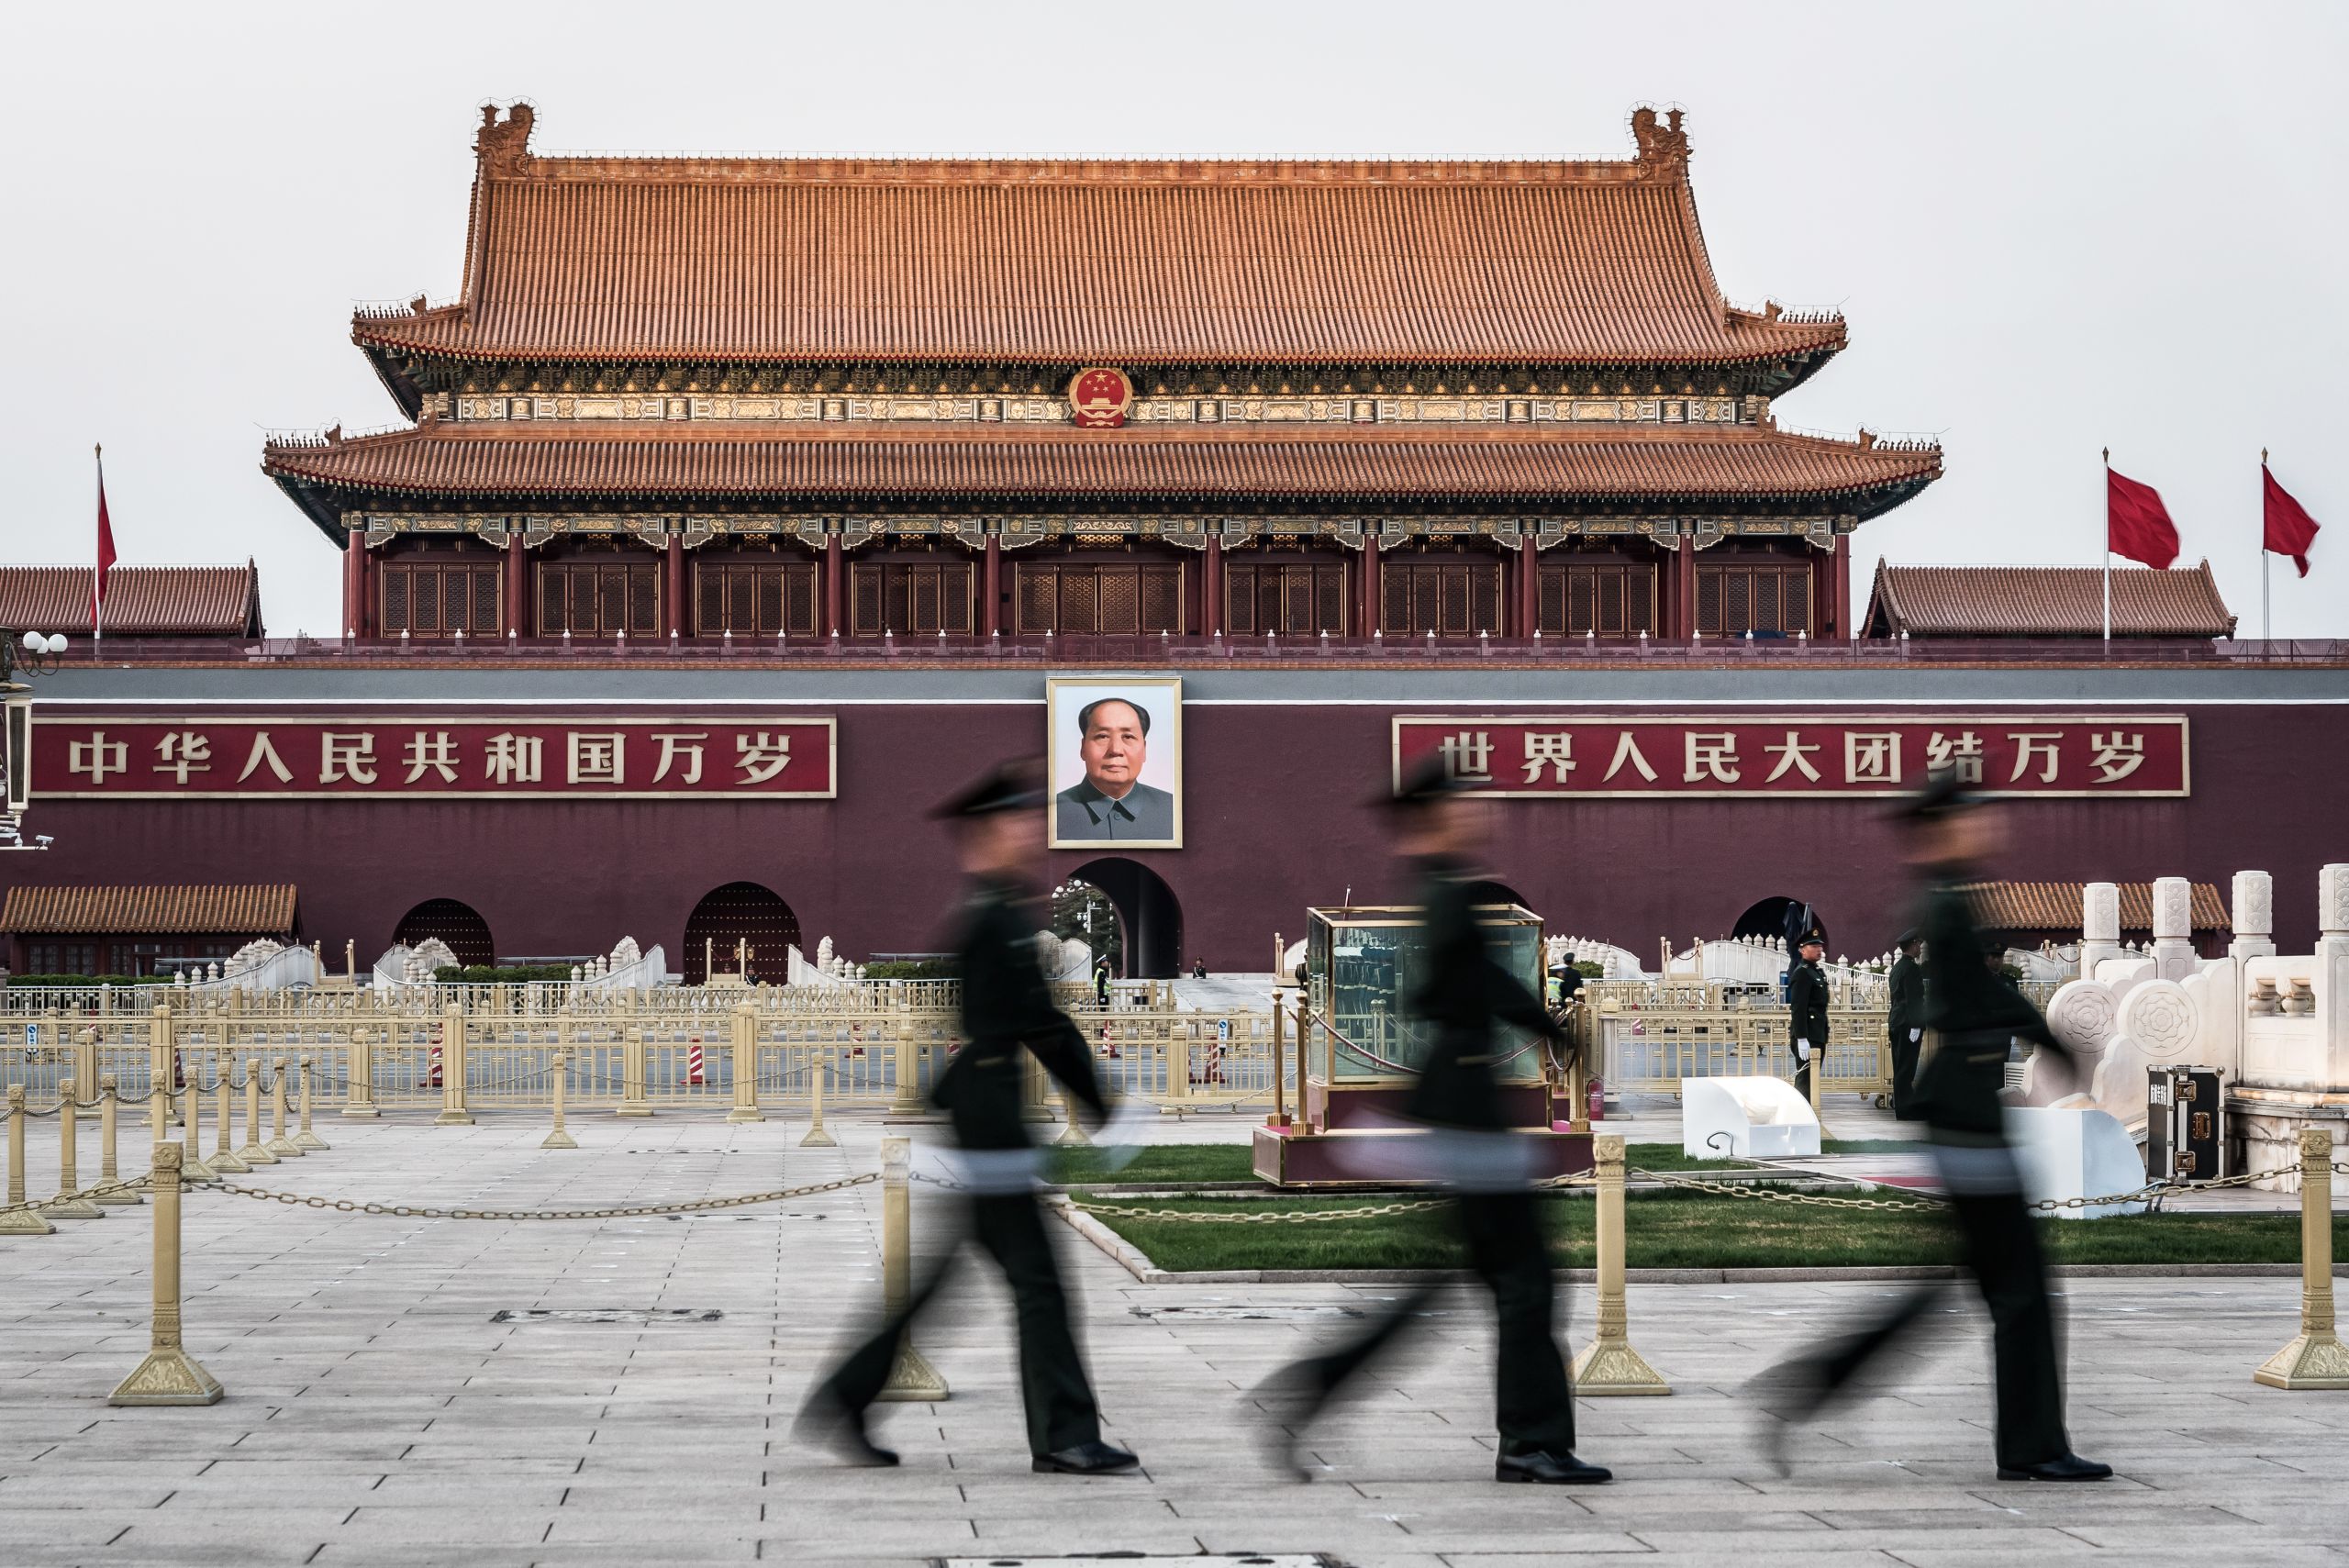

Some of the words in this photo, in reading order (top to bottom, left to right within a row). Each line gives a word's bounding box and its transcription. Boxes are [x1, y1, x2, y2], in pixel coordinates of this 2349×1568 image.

[69, 731, 792, 784] 中华人民共和国万岁
[1438, 730, 2145, 784] 世界人民大团结万岁
